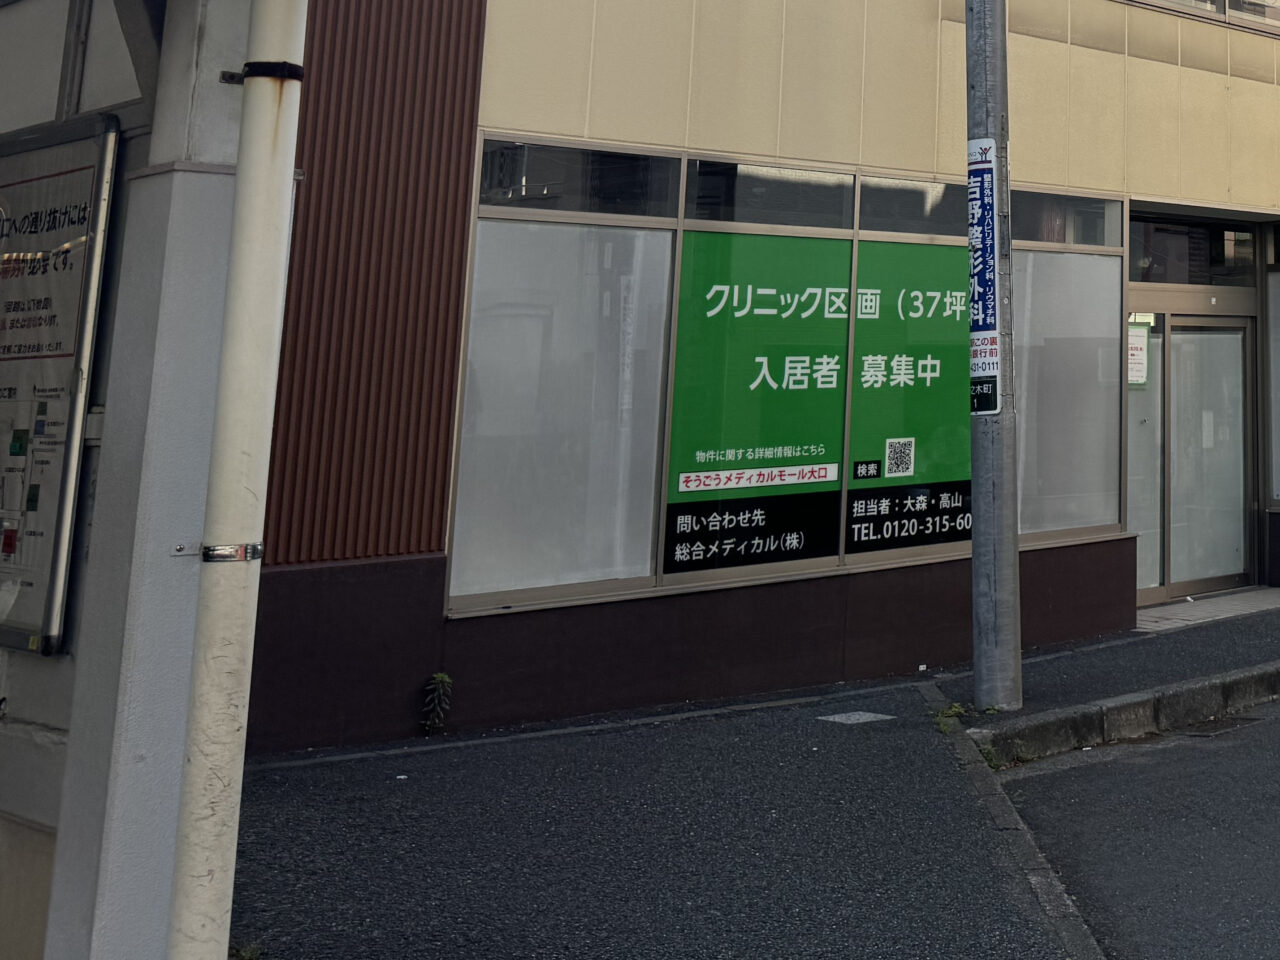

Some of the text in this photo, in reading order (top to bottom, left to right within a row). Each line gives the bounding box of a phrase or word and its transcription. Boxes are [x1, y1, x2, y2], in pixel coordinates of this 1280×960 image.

[0, 201, 88, 238] 口への通り抜けには
[968, 175, 984, 327] 吉野整形外科
[970, 348, 998, 359] 銀行前
[749, 354, 941, 391] 入居者 募集中
[695, 443, 827, 463] 物件に関する詳細情報はこちら
[682, 466, 828, 490] そうごうメディカルモール大口
[857, 462, 879, 478] 検索
[676, 509, 766, 534] 問い合わせ先
[851, 512, 972, 542] TEL.0120-315-60
